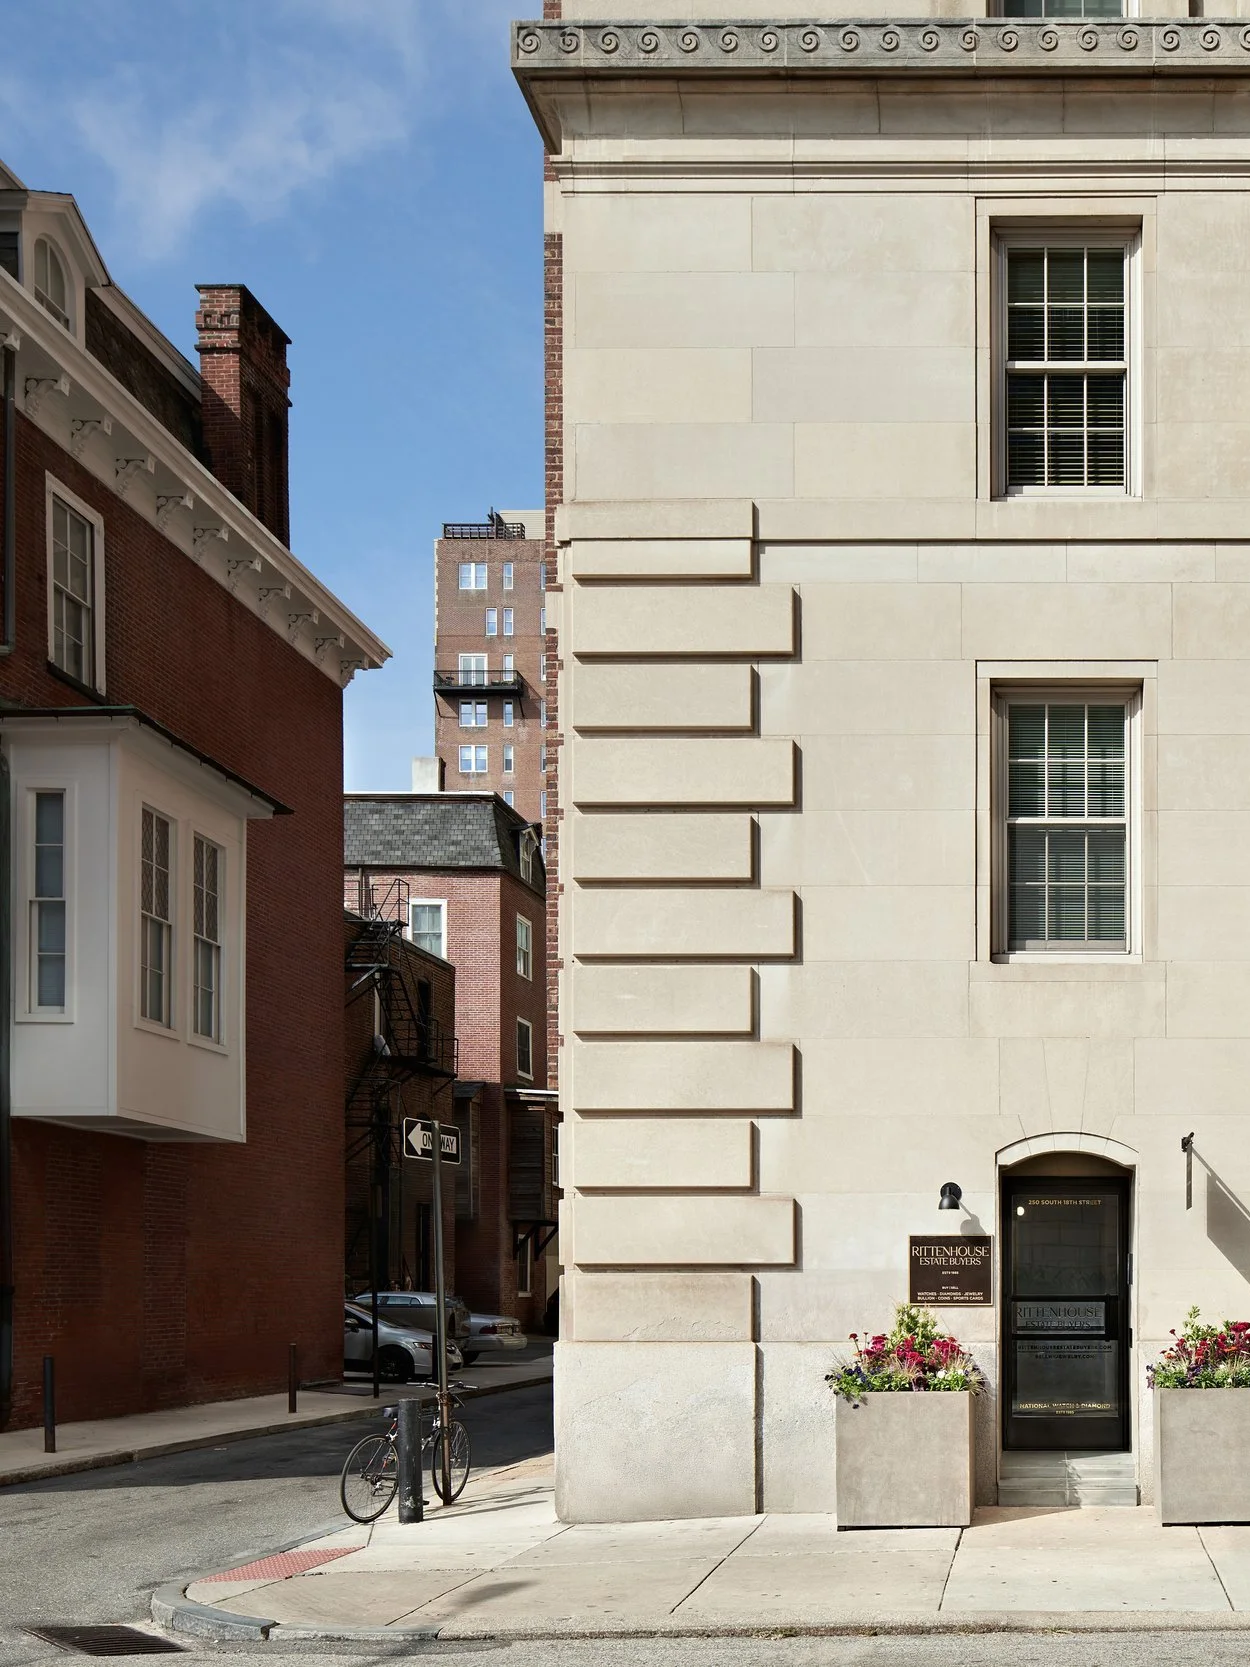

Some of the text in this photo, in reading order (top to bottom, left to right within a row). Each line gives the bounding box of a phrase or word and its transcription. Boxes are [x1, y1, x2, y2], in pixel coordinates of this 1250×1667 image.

[440, 1136, 455, 1151] WAY
[912, 1246, 989, 1257] RITTENHOUSE
[919, 1257, 981, 1266] ESTATE BUYERS
[1016, 1307, 1102, 1318] RITTENHOUSE
[1025, 1320, 1091, 1328] ESTATE BUYERS
